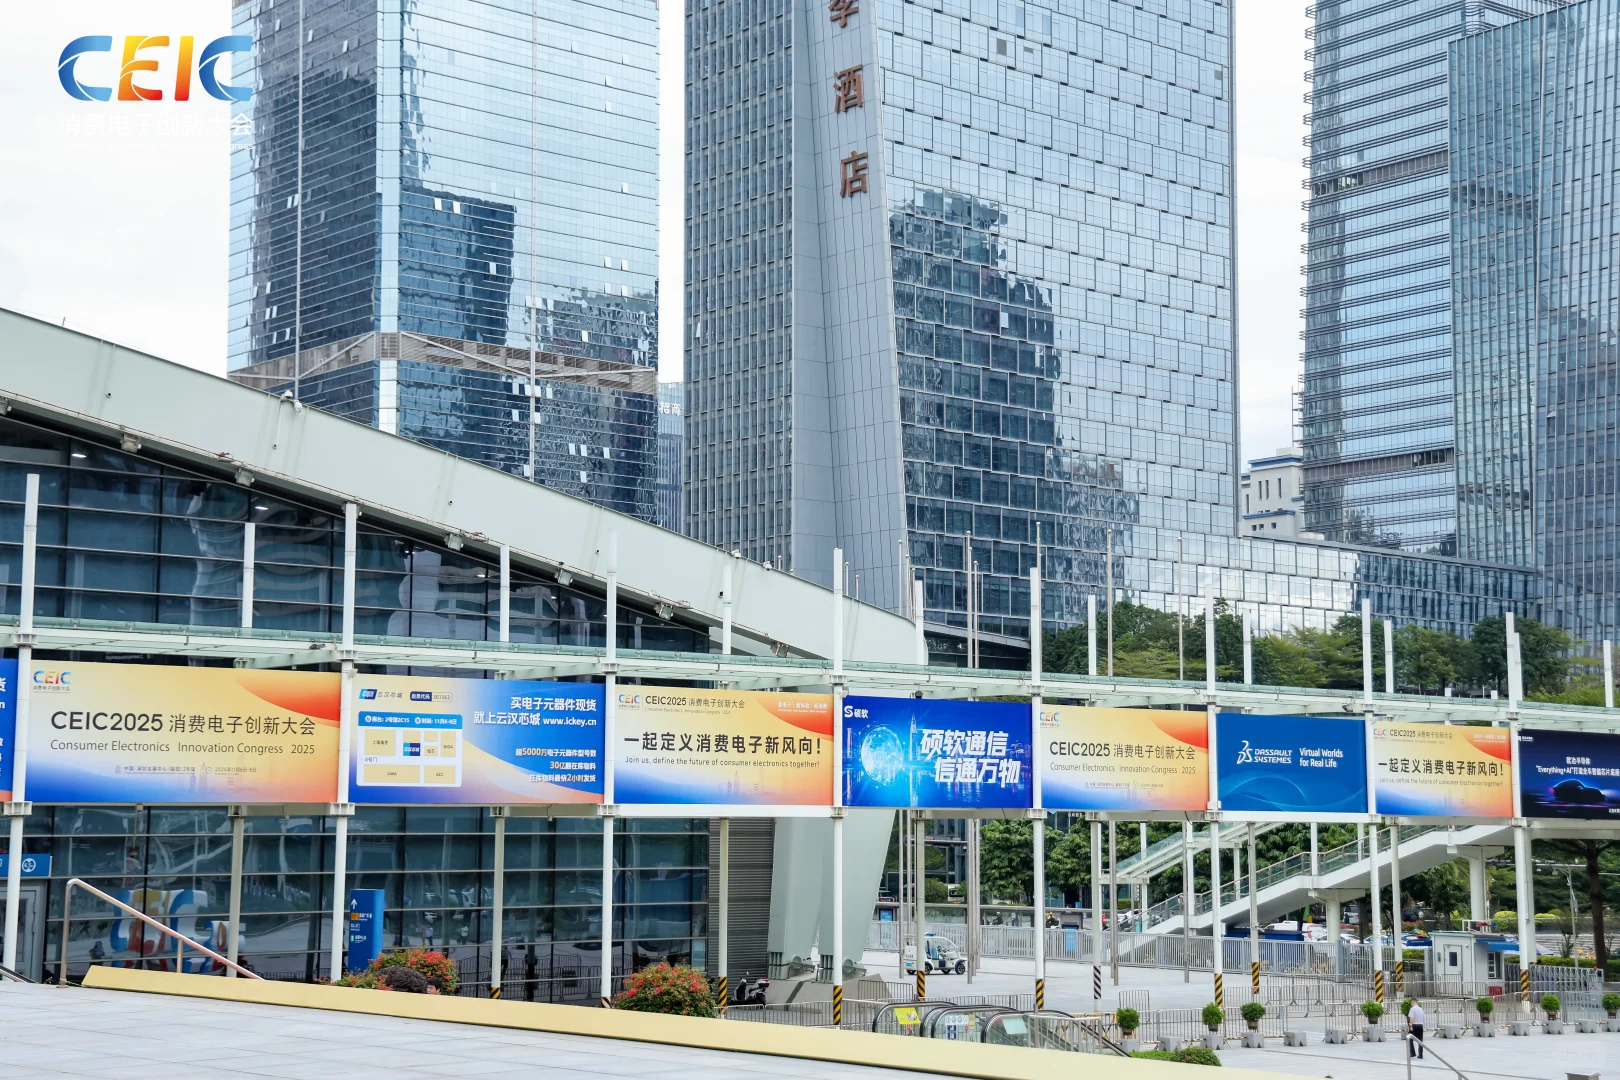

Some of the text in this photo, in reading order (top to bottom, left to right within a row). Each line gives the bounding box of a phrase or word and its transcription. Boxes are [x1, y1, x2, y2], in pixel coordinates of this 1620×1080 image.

[659, 401, 683, 416] 招商
[33, 670, 71, 685] CEIC
[511, 697, 597, 712] 买电子元器件现货
[618, 693, 640, 704] CEIC
[645, 695, 745, 709] CEIC2025 消费电子创新大会
[473, 711, 597, 728] 就上云汉芯城 www.ickey.cn
[854, 708, 869, 719] 硕软
[51, 711, 316, 736] CEIC2025 消费电子创新大会
[1373, 728, 1387, 736] CEIC
[1390, 729, 1416, 737] CEIC2025
[51, 739, 315, 756] Consumer Electronics Innovation Congress 2025
[920, 729, 1009, 761] 硕软通信
[1050, 741, 1196, 761] CEIC2025 消费电子创新大会
[515, 748, 597, 757] 超5000万电子元器件型号数
[1254, 749, 1292, 757] DASSAULT
[1299, 748, 1343, 758] Virtual Worlds
[625, 756, 640, 764] Join
[653, 757, 675, 765] define
[676, 757, 687, 765] the
[689, 758, 710, 766] future
[711, 758, 719, 766] of
[789, 760, 820, 769] together!
[1050, 762, 1196, 775] Consumer Electronics Innovation Congress 2025
[1299, 758, 1338, 768] for Real Life
[934, 757, 1021, 788] 信通万物
